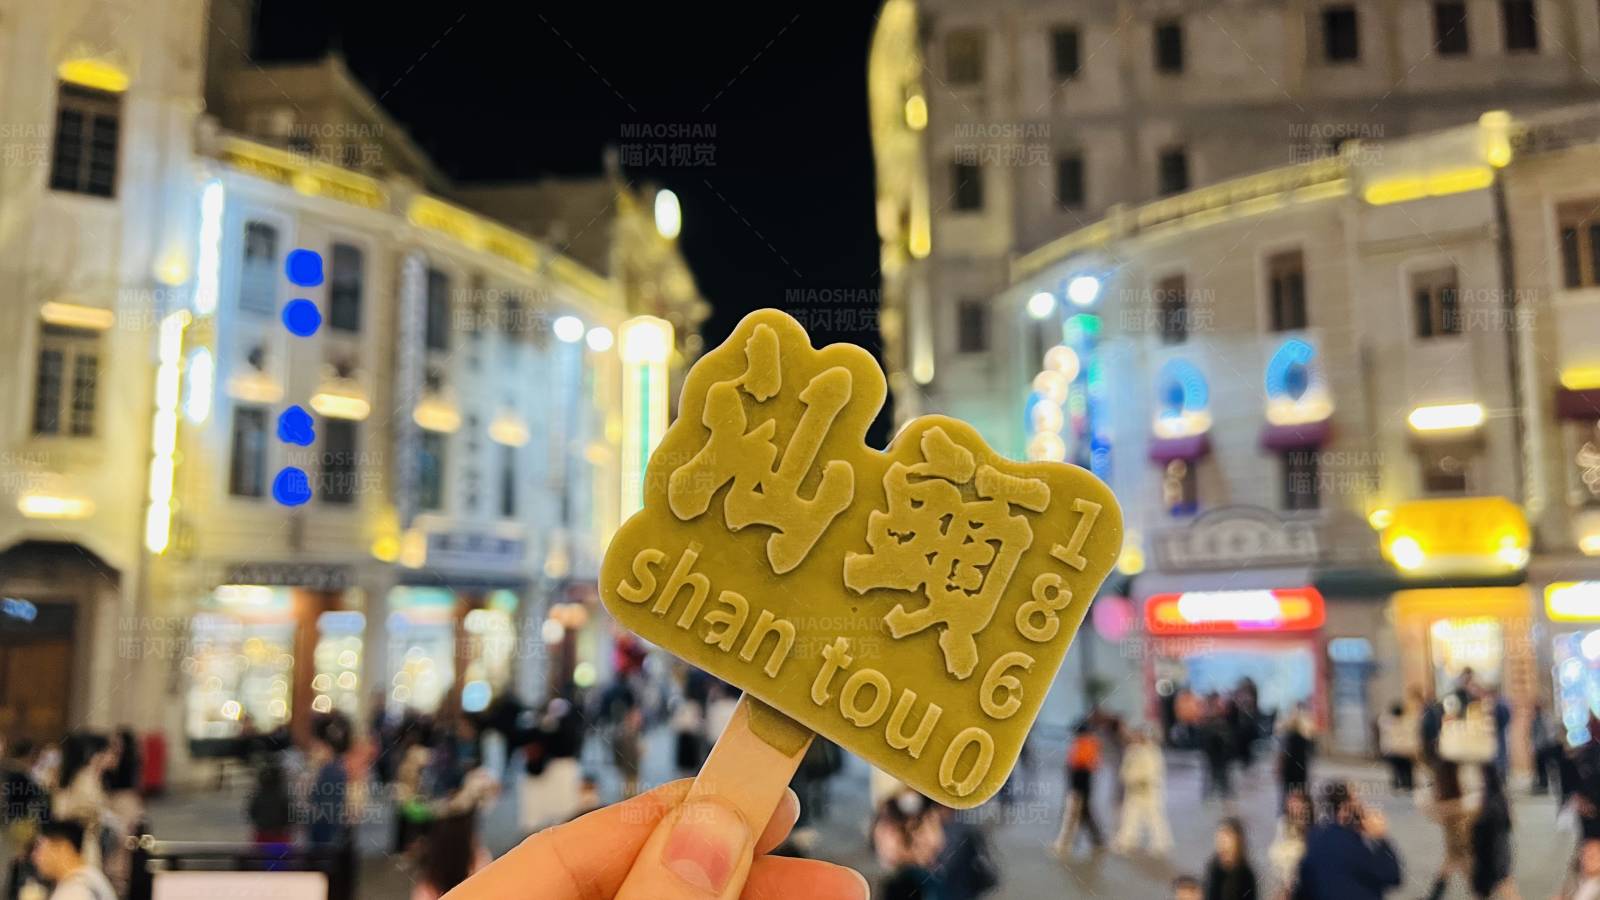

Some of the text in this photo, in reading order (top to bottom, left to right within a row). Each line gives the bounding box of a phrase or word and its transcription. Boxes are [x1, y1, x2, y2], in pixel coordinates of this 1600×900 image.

[616, 542, 943, 759] shan tou
[939, 498, 1103, 797] 1860
